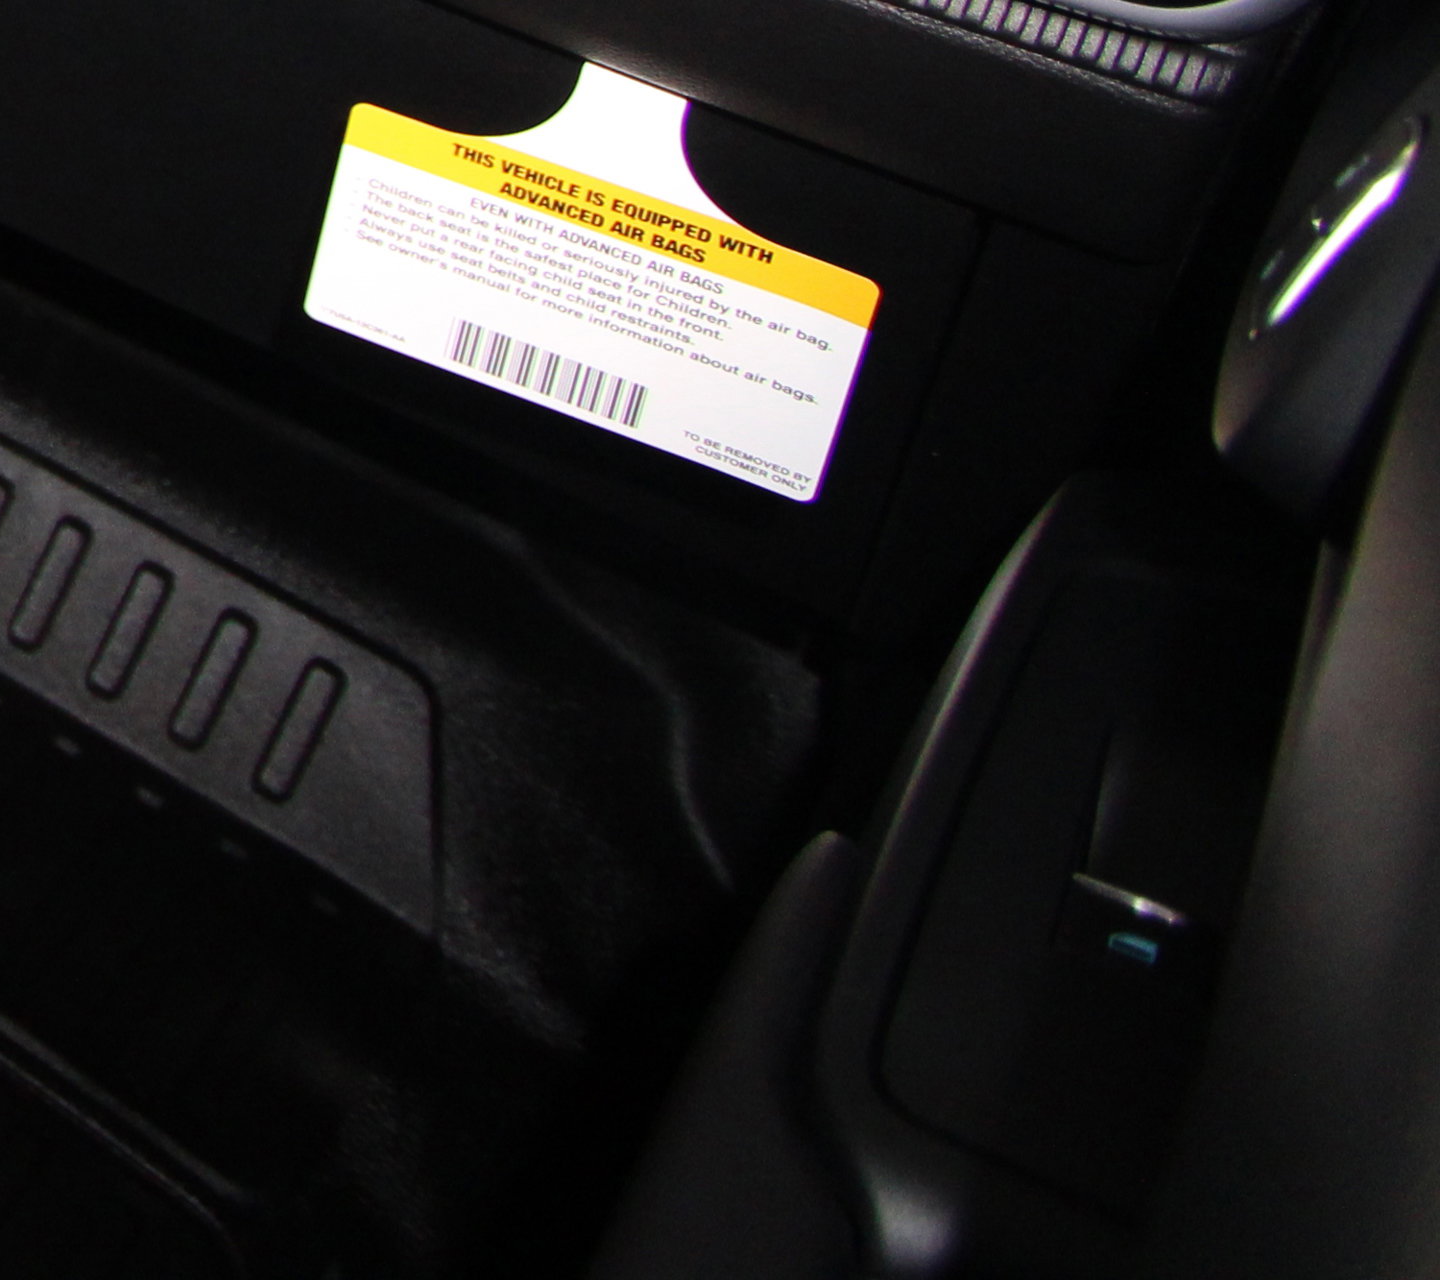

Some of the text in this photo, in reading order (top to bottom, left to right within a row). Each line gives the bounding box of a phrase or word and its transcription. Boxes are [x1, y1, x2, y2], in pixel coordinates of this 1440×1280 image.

[367, 190, 733, 331] The back seat is the safest place for Children.
[368, 178, 833, 354] Children can be killed or seriously injured by the air bag.
[452, 142, 775, 265] THIS VEHICLE IS EQUIPPED WITH
[470, 197, 726, 295] EVEN WITH ADVANCED AIR BAGS
[499, 182, 707, 263] ADVANCED AIR BAGS
[356, 229, 819, 405] See owner's manual for more information about air bags.
[359, 218, 696, 347] Always use seat belts and child restraints.
[362, 204, 725, 343] Never put a rear facing child seat in the front.
[683, 429, 812, 484] TO BE REMOVED BY
[694, 444, 807, 492] CUSTOMER ONLY
